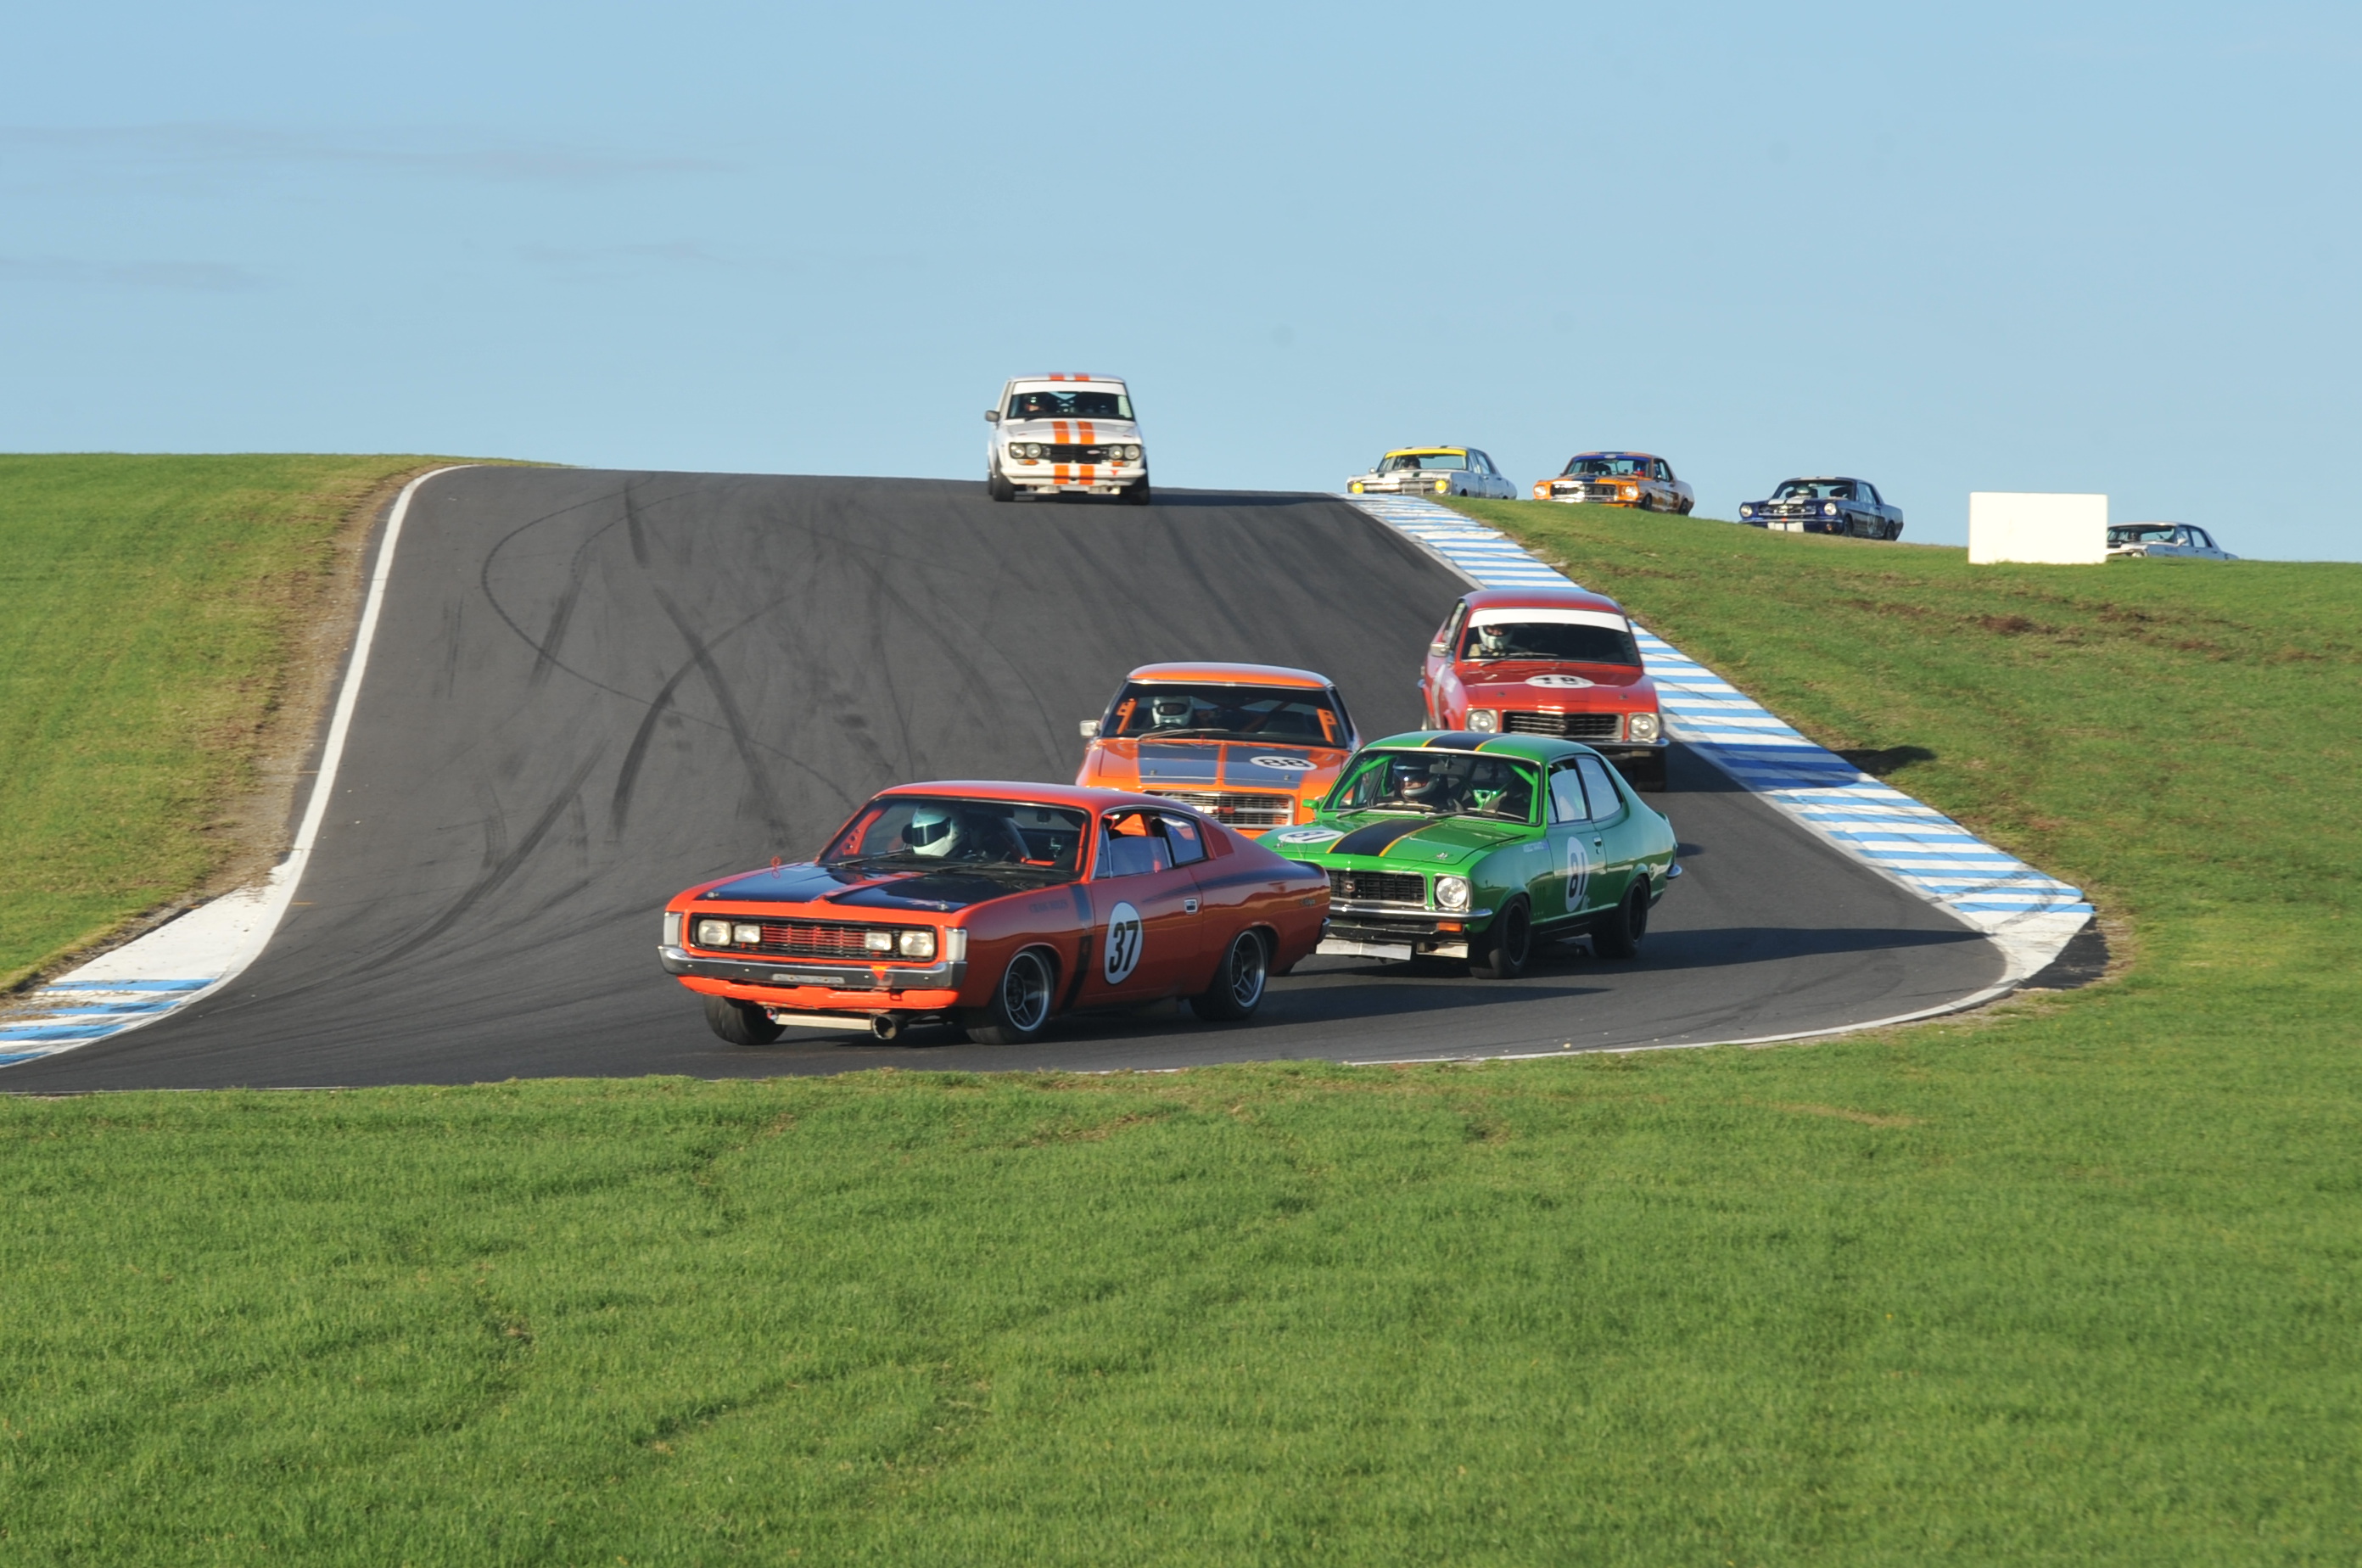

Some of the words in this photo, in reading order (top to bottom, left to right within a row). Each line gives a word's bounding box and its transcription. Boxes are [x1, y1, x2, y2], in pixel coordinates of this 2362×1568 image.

[1258, 759, 1310, 768] 88
[1287, 831, 1336, 842] 81
[1569, 852, 1586, 899] 81
[1108, 919, 1139, 974] 37
